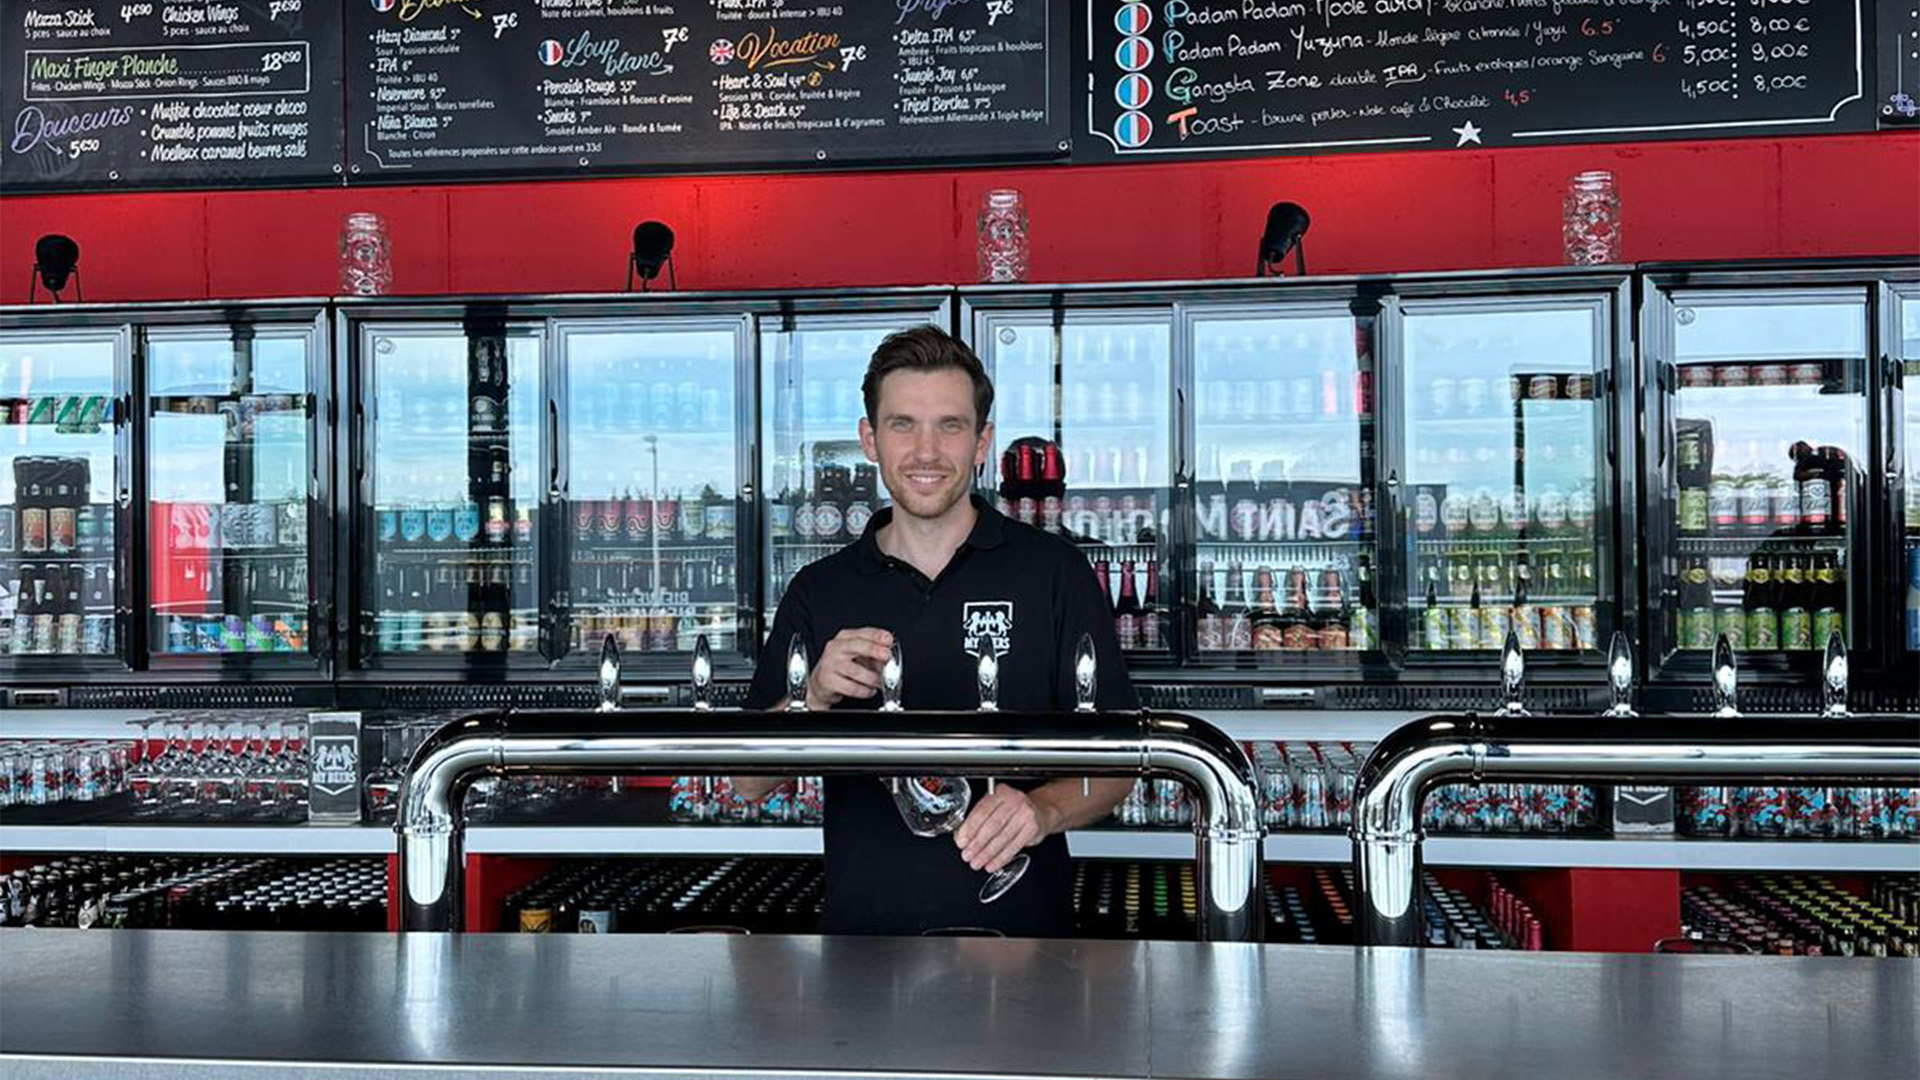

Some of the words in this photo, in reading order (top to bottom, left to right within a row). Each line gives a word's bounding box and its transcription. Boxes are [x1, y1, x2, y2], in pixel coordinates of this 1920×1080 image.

[24, 10, 62, 27] Mozza
[65, 8, 95, 27] Stick
[162, 5, 205, 23] Chicken
[207, 4, 239, 24] Wings
[561, 9, 571, 17] de
[986, 0, 1014, 26] 7€
[1164, 0, 1238, 27] Padam
[1242, 0, 1306, 25] Padam
[32, 29, 50, 40] pces
[56, 29, 78, 38] sauce
[80, 29, 89, 37] au
[90, 26, 111, 36] choix
[162, 26, 169, 36] 5
[170, 26, 189, 37] pces
[194, 26, 217, 35] sauce
[218, 26, 227, 34] au
[228, 23, 250, 33] choix
[376, 28, 401, 46] Hazy
[403, 25, 447, 43] Diamond
[492, 12, 518, 39] 7€
[900, 29, 930, 45] Delta
[932, 27, 954, 44] IPA
[562, 29, 620, 68] Loup
[661, 26, 689, 53] 7€
[736, 26, 840, 69] Vocation
[1162, 29, 1224, 64] Padam
[1227, 34, 1281, 57] Padam
[31, 57, 72, 80] Maxi
[74, 56, 118, 82] Finger
[121, 53, 179, 76] Planche
[376, 57, 397, 73] IPA
[605, 51, 663, 76] blanc
[839, 44, 867, 72] 7€
[55, 81, 83, 91] Chicken
[83, 80, 106, 92] Wings
[134, 78, 151, 89] Stick
[154, 78, 178, 88] Onion
[178, 77, 198, 89] Rings
[719, 73, 751, 90] Heart
[752, 73, 763, 88] &
[764, 72, 787, 88] Soul
[901, 67, 935, 86] Jungle
[936, 66, 956, 84] Joy
[1165, 67, 1256, 105] Gangsta
[1265, 70, 1322, 90] Zone
[1329, 69, 1378, 88] double
[1383, 63, 1418, 82] IPA
[585, 78, 617, 96] Rouge
[151, 102, 190, 122] Muffin
[193, 101, 241, 118] chocolat
[274, 98, 308, 115] choco
[720, 103, 740, 121] Life
[741, 103, 752, 119] &
[754, 101, 787, 119] Death
[902, 97, 931, 115] Tripel
[932, 95, 970, 112] Bertha
[543, 108, 577, 125] Smoke
[1166, 107, 1245, 141] Toast
[1432, 94, 1491, 111] Chocolat
[11, 105, 134, 153] Douceurs
[151, 122, 195, 141] Crumble
[237, 120, 270, 141] fruits
[272, 122, 308, 139] rouges
[200, 142, 246, 160] caramel
[247, 143, 282, 159] beurre
[284, 139, 307, 157] salé
[964, 637, 980, 649] MY
